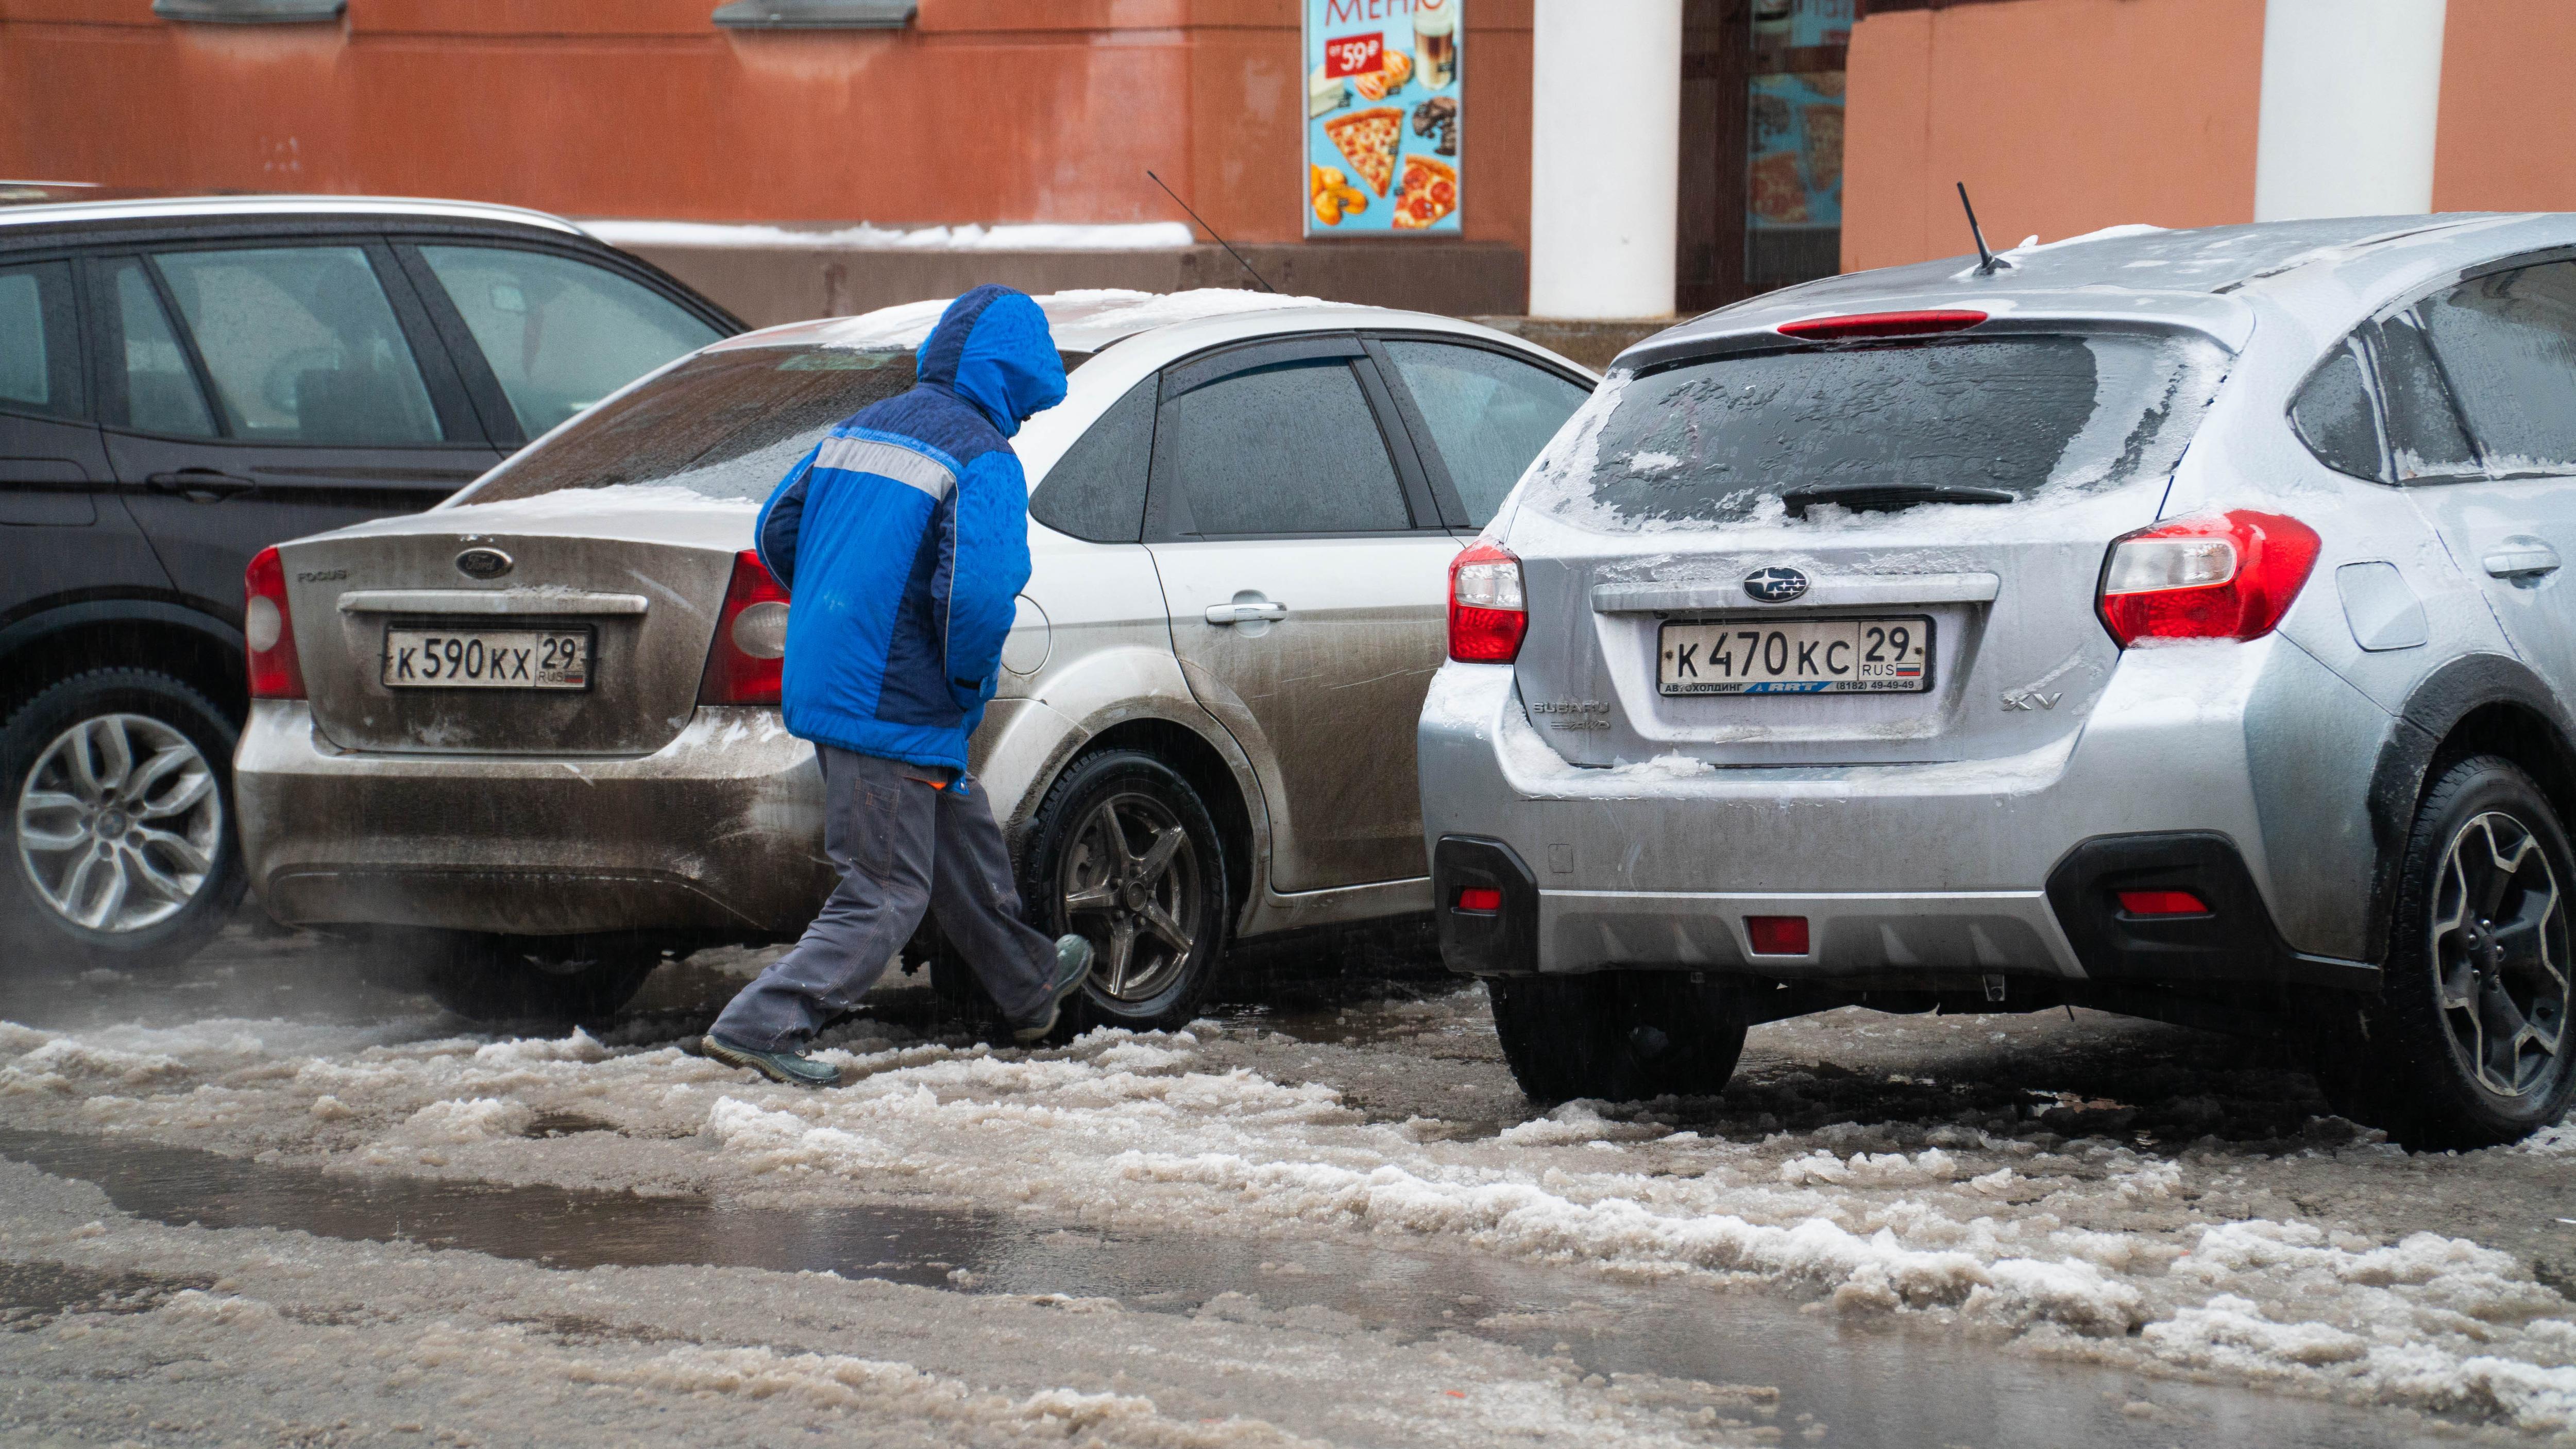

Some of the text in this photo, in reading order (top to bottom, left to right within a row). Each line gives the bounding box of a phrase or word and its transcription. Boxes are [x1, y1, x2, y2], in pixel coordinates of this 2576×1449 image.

[1678, 626, 1910, 677] К470КС 29
[397, 637, 576, 679] К590КХ 29
[1862, 664, 1894, 676] RUS
[538, 671, 564, 683] RUS
[1836, 681, 1867, 690] (8182)
[1871, 680, 1914, 689] 49-49-49
[1533, 701, 1609, 713] SUBARU
